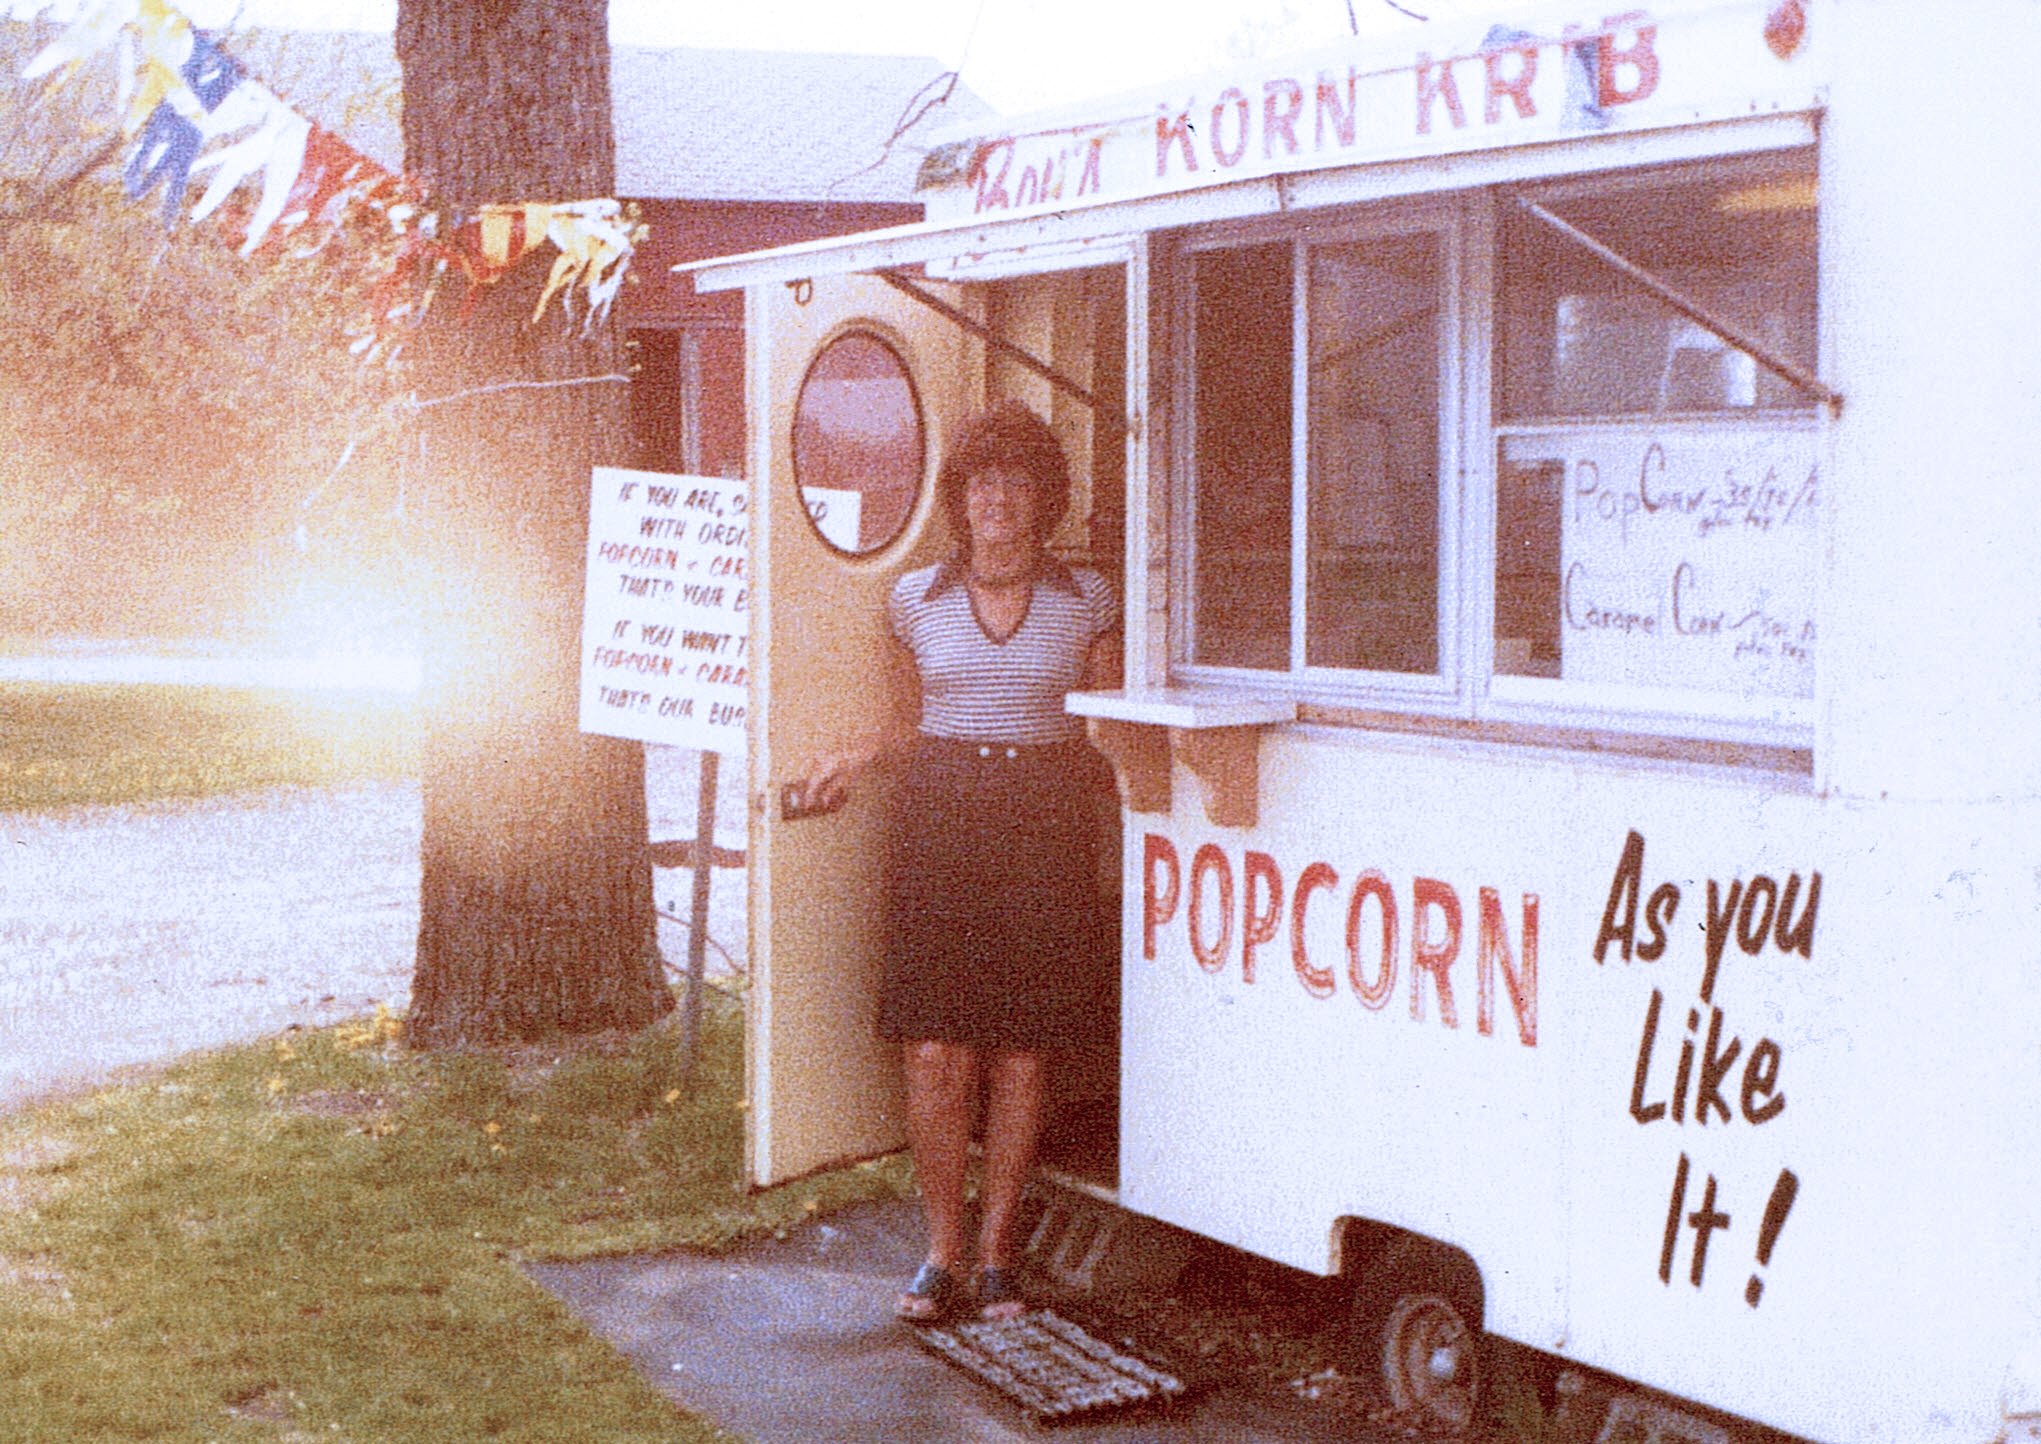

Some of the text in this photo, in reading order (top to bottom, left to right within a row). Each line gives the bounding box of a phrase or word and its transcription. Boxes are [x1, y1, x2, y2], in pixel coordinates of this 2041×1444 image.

[1155, 65, 1357, 177] KORN
[619, 482, 639, 502] IF
[648, 485, 679, 509] YOU
[640, 516, 748, 549] WITH ORDI
[599, 541, 748, 580] POPCORN CAR
[684, 583, 725, 609] YOUR
[641, 624, 674, 647] YOU
[682, 629, 731, 654] WANT
[697, 662, 748, 686] CARA
[1143, 828, 1823, 1049] POPCORN As you
[1629, 987, 1786, 1126] Like
